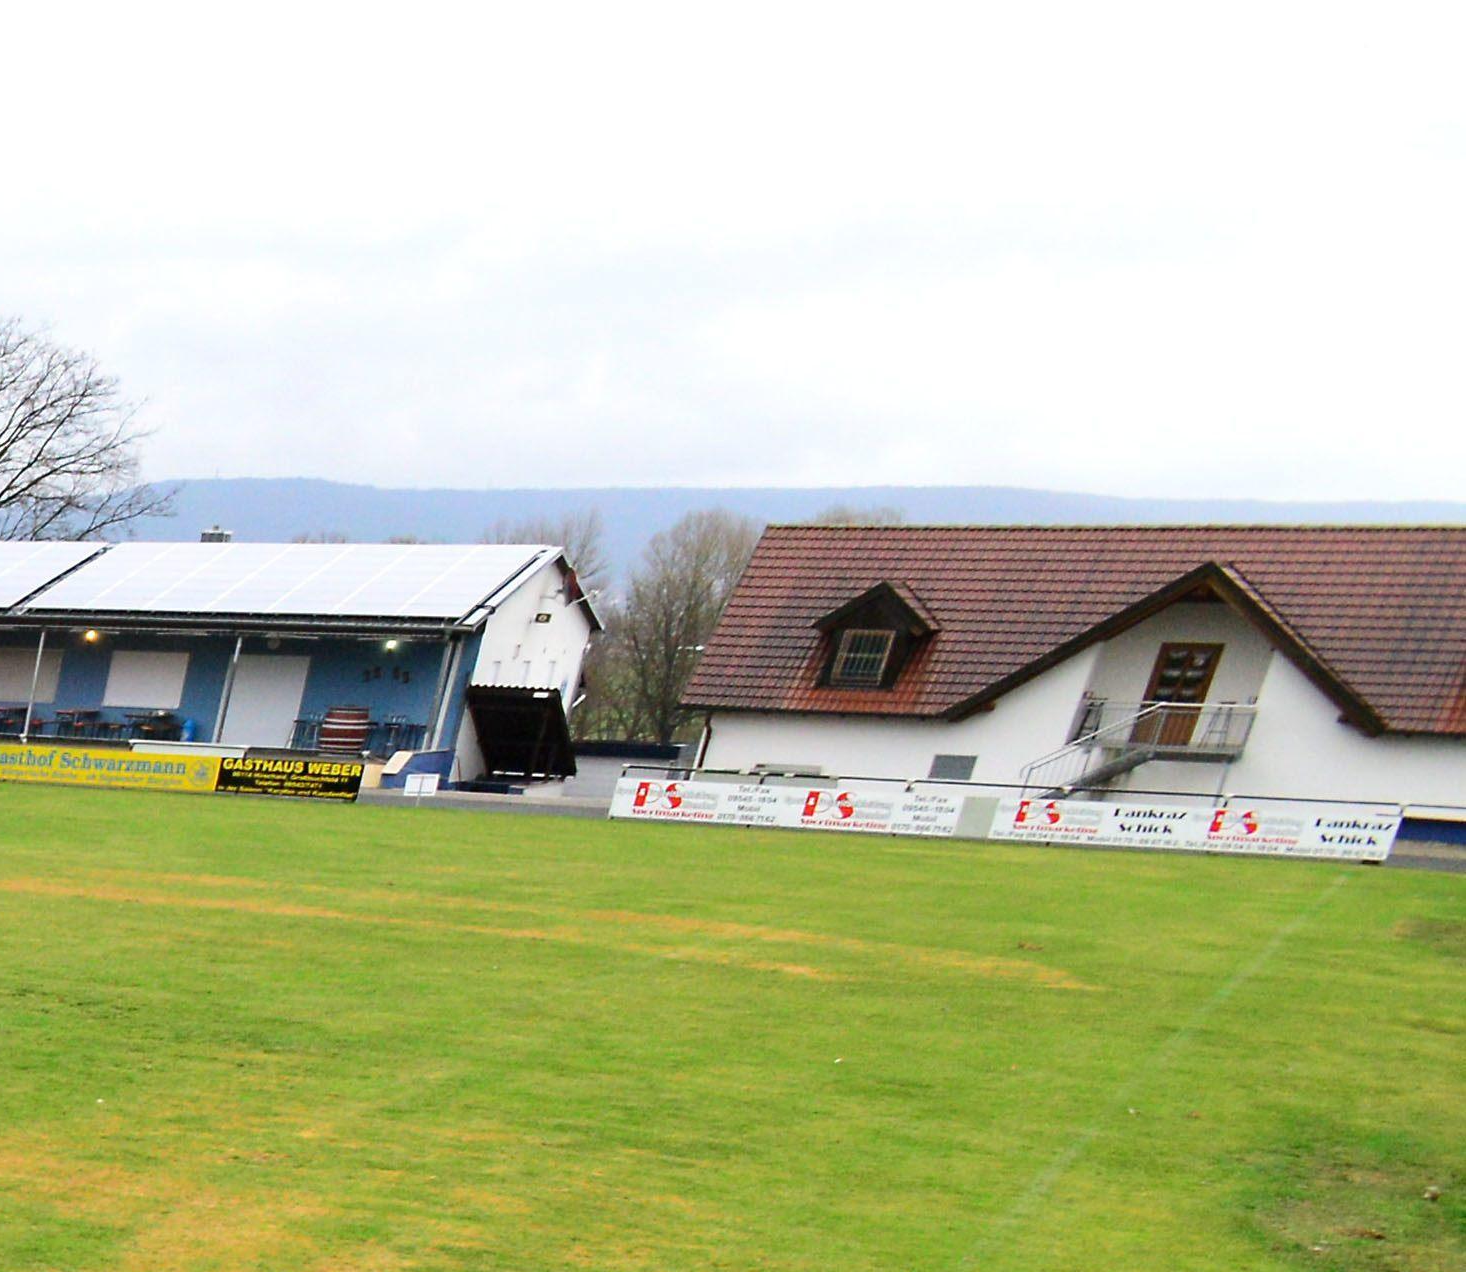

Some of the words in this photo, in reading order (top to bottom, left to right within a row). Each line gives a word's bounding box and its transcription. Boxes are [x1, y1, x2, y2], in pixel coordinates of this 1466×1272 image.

[59, 752, 187, 775] Schwarzmann
[222, 758, 304, 774] GASTHAUS
[308, 762, 363, 777] WEBER
[1118, 823, 1173, 834] Schick
[1320, 834, 1378, 846] Schick
